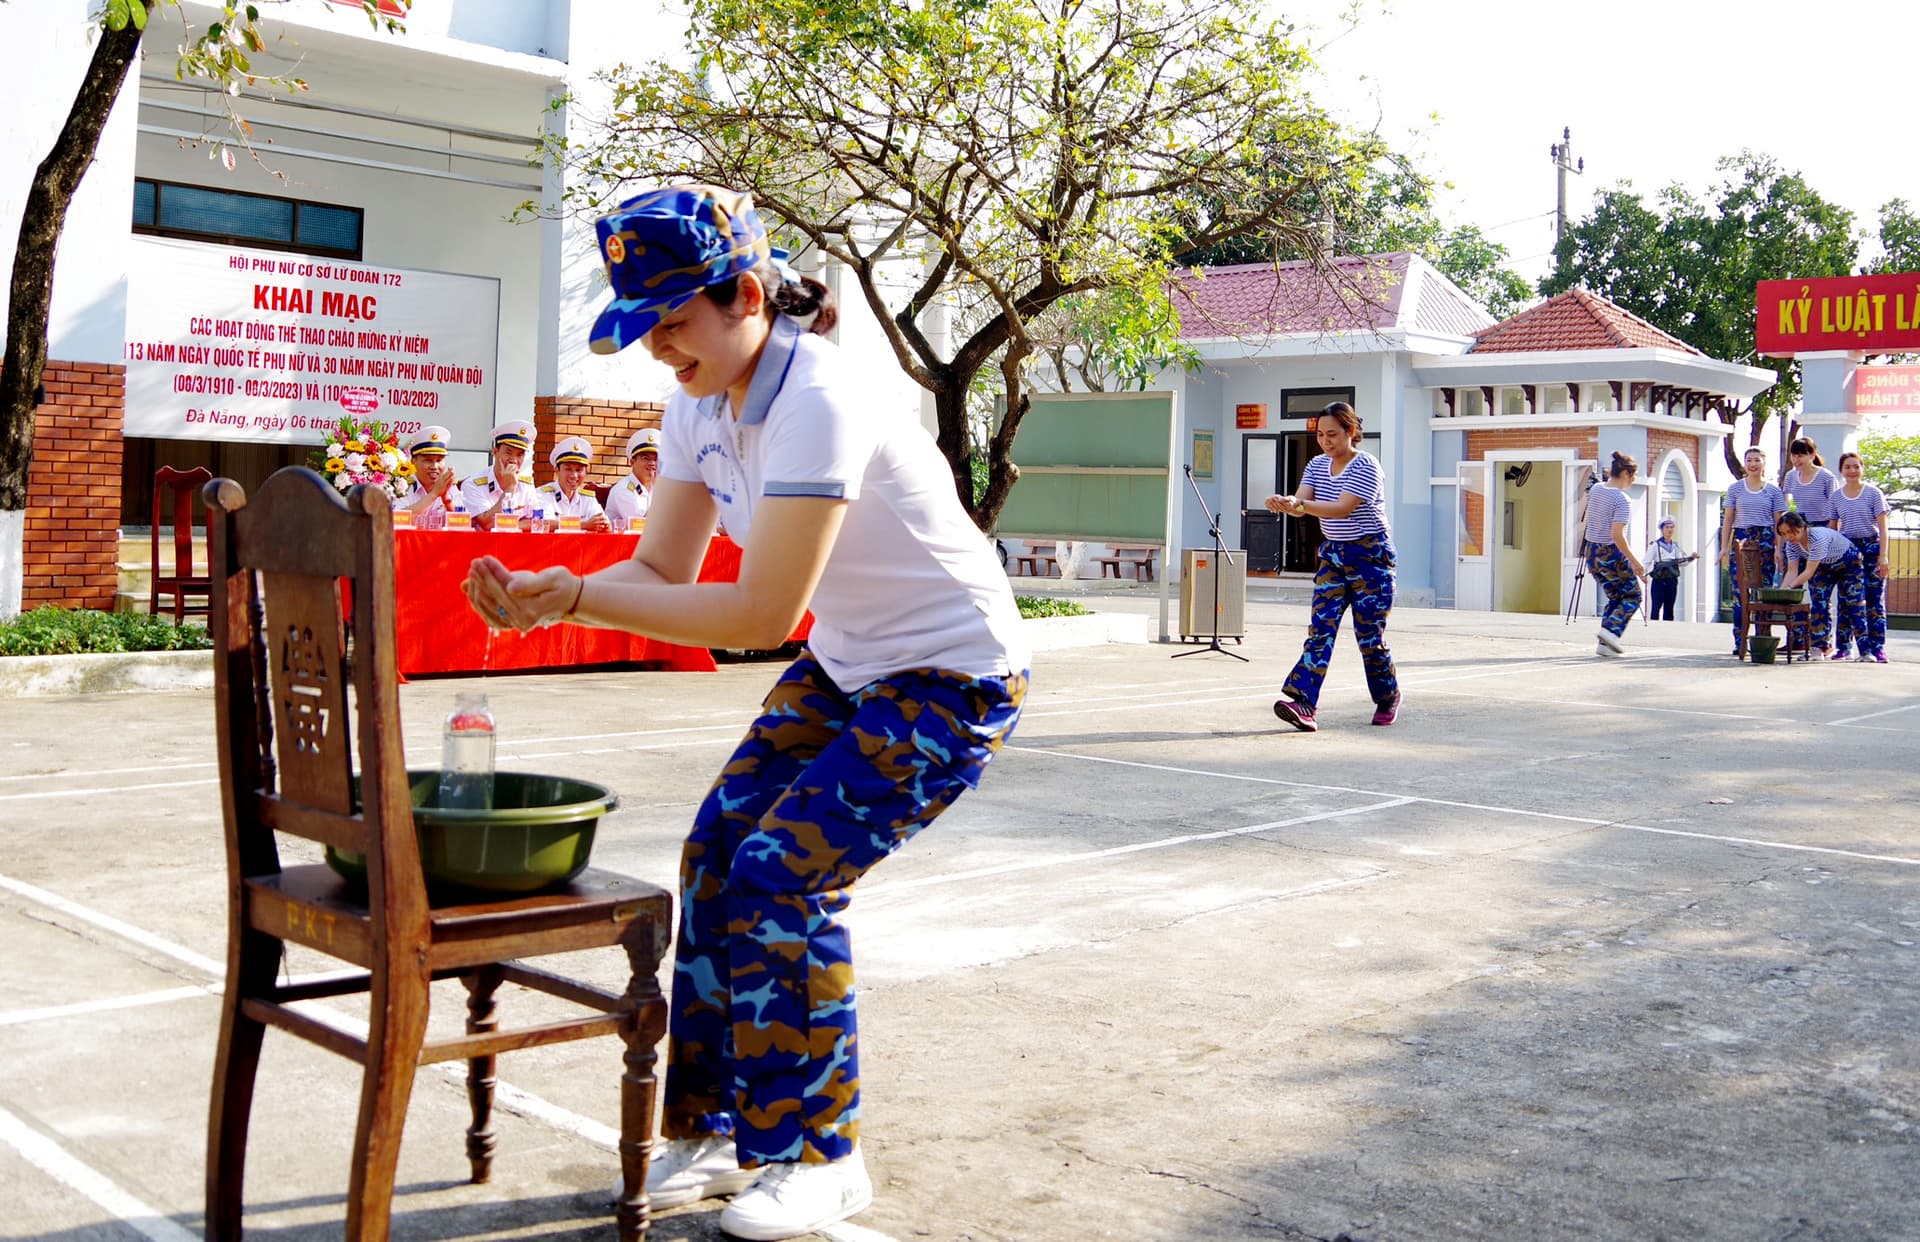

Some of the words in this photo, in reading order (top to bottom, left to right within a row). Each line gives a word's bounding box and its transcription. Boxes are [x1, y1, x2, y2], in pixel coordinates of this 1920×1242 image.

[229, 254, 248, 272] HỘI
[252, 259, 275, 276] PHỤ
[279, 260, 296, 275] NỮ
[298, 264, 314, 277] CƠ
[316, 262, 332, 278] SỞ
[334, 266, 348, 280] LỮ
[350, 268, 380, 284] ĐOÀN
[383, 273, 402, 287] 172
[253, 284, 313, 314] KHAI
[321, 291, 377, 323] MẠC
[1779, 285, 1812, 334] KỶ
[1822, 288, 1886, 337] LUẬT
[190, 314, 212, 336] CÁC
[216, 320, 243, 341] HOẠT
[246, 319, 275, 343] ĐỘNG
[278, 318, 297, 343] THỂ
[300, 327, 325, 345] THAO
[328, 327, 355, 348] CHÀO
[358, 330, 387, 350] MỪNG
[390, 330, 402, 352] KỶ
[404, 334, 429, 356] NIỆM
[147, 341, 175, 362] NĂM
[179, 342, 210, 364] NGÀY
[214, 344, 244, 368] QUỐC
[248, 345, 262, 368] TẾ
[264, 352, 285, 374] PHỤ
[289, 351, 305, 371] NỮ
[307, 352, 321, 373] VÀ
[324, 357, 337, 374] 30
[340, 355, 364, 376] NĂM
[368, 357, 395, 378] NGÀY
[397, 363, 417, 383] PHỤ
[421, 362, 436, 381] NỮ
[437, 363, 463, 384] QUÂN
[466, 365, 483, 388] ĐỘI
[306, 380, 320, 401] VÀ
[388, 389, 439, 410] 10/3/2023)
[186, 408, 205, 423] Đà
[209, 408, 249, 429] Nẵng,
[253, 414, 287, 430] ngày
[291, 415, 306, 428] 06
